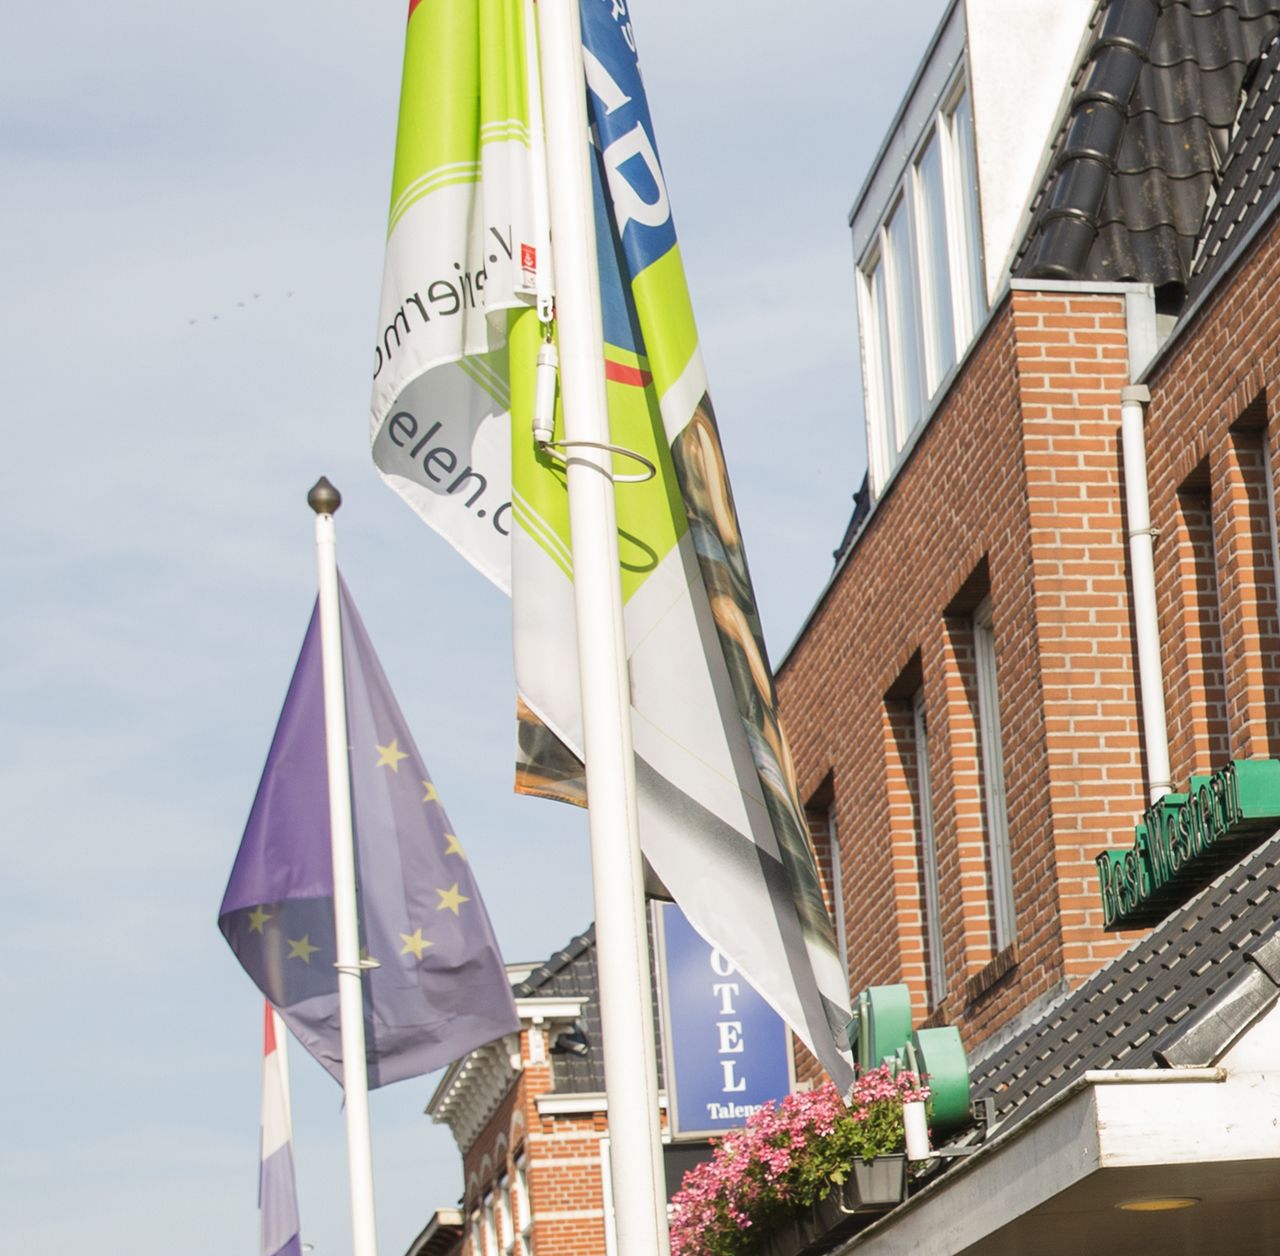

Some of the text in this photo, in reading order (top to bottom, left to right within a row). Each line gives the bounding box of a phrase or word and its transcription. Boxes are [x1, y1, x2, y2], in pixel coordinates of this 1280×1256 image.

[1096, 764, 1241, 928] Best Western
[709, 947, 747, 1092] OTEL
